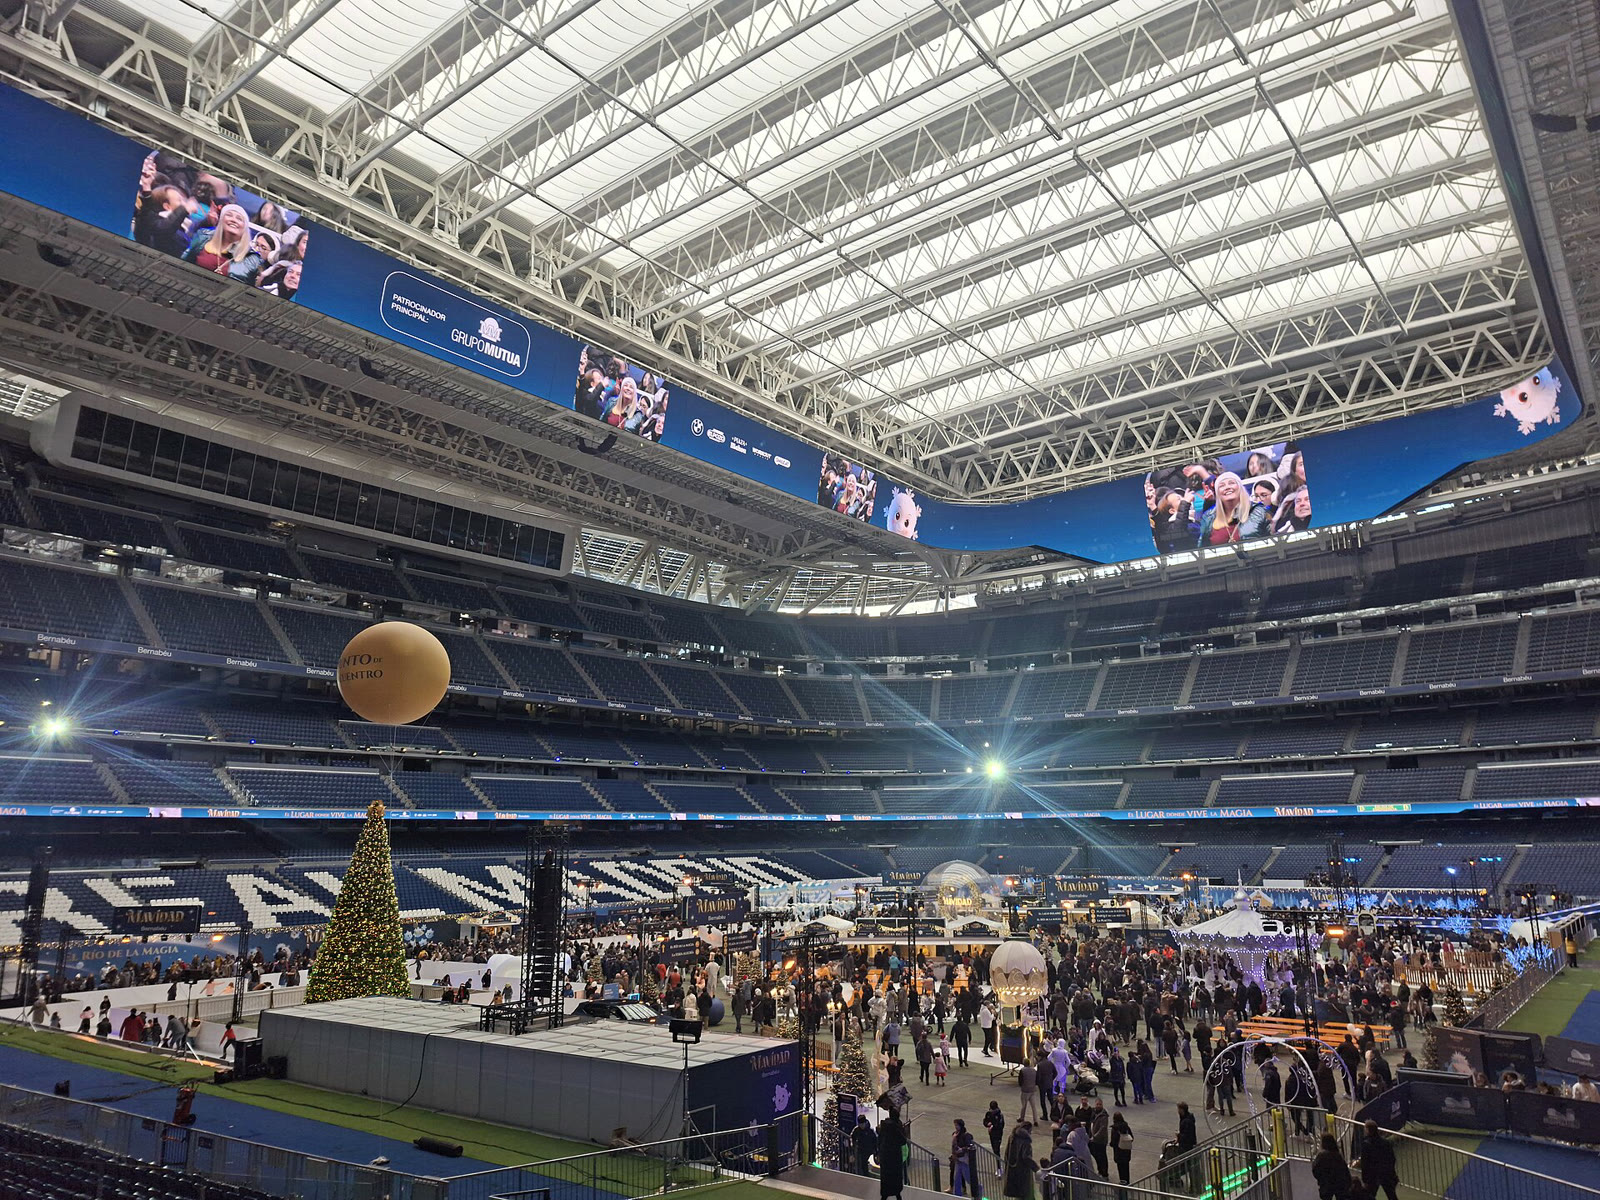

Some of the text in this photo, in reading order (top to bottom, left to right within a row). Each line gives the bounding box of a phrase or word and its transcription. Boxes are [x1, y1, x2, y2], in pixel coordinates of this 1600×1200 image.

[392, 293, 446, 321] PATROCINADOR
[391, 302, 429, 323] PRINCIPAL:
[37, 634, 76, 646] Bernabéu
[137, 647, 172, 657] Bernabéu
[227, 658, 257, 667] Bernabéu
[307, 667, 334, 677] Bernabéu
[1503, 675, 1532, 683] Bernabéu
[1429, 682, 1456, 690] Bernabéu
[1360, 688, 1386, 696] Bernabéu
[1136, 810, 1166, 819] LUGAR
[1186, 810, 1208, 818] VIVE
[1220, 809, 1253, 817] MAGIA
[108, 949, 122, 958] DE
[126, 947, 139, 957] LA
[142, 945, 179, 956] MAGIA
